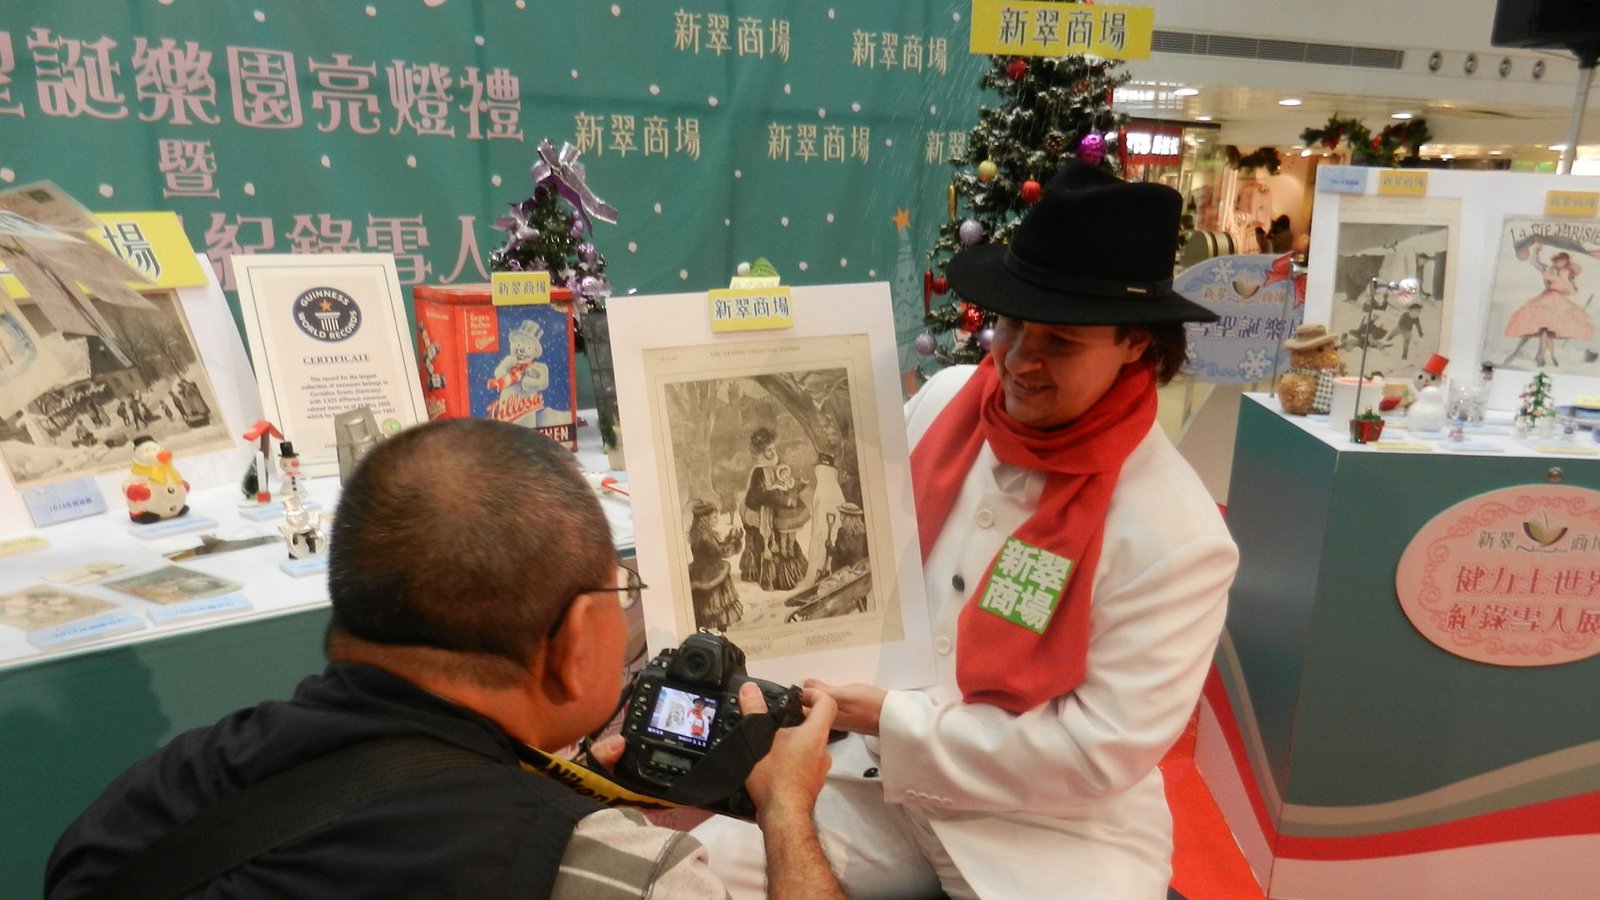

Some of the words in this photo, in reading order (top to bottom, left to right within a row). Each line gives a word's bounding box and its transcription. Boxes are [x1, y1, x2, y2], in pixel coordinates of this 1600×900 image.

[673, 9, 791, 63] 新翠商場
[1000, 7, 1128, 50] 新翠商場
[851, 28, 949, 76] 新翠商場
[574, 111, 702, 161] 新翠商場
[768, 121, 871, 165] 新翠商場
[158, 139, 221, 199] 暨
[300, 289, 350, 308] GUINNESS
[499, 281, 546, 296] 新翠商場
[714, 296, 790, 320] 新翠商場
[298, 310, 326, 340] WORLD
[329, 309, 358, 341] RECORDS
[302, 353, 371, 365] CERTIFICATE
[541, 427, 569, 441] HEN
[1478, 531, 1516, 549] 新翠
[998, 540, 1072, 591] 新翠
[982, 574, 1054, 629] 商場
[549, 762, 609, 803] Nikon
